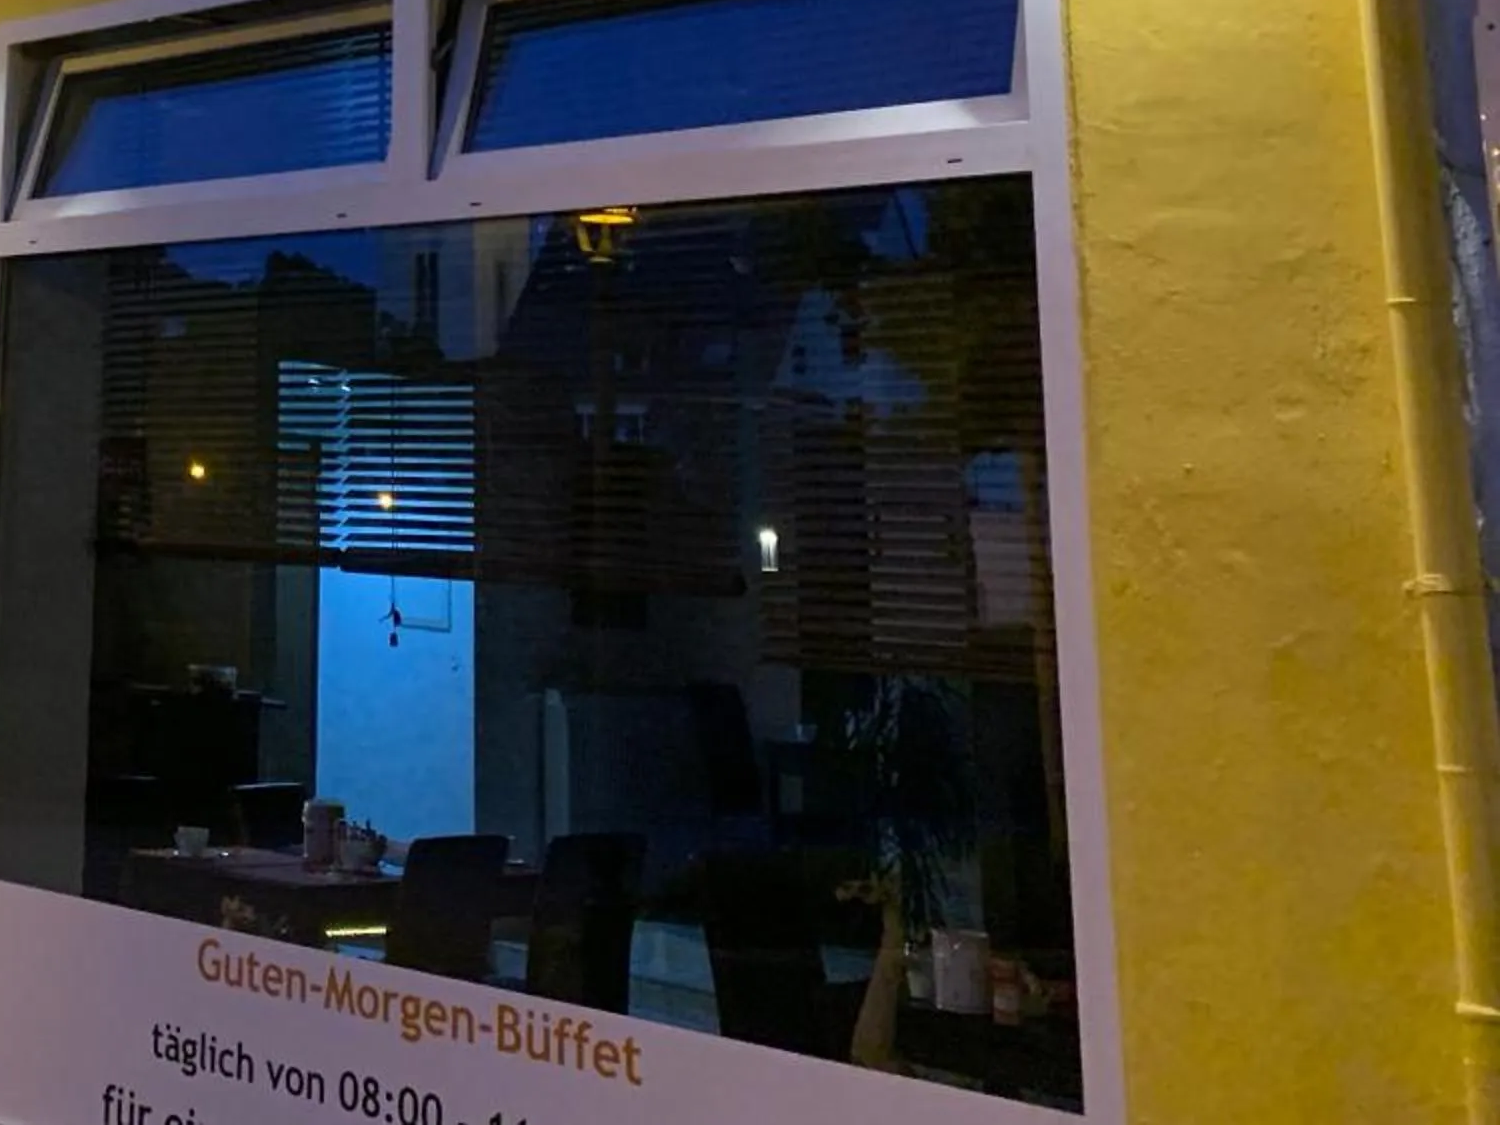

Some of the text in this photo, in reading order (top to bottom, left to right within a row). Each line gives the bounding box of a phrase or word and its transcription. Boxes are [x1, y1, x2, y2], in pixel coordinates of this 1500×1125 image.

[197, 938, 642, 1086] Guten-Morgen-Büffet
[102, 1083, 152, 1125] für
[152, 1023, 443, 1125] täglich von 08:00
